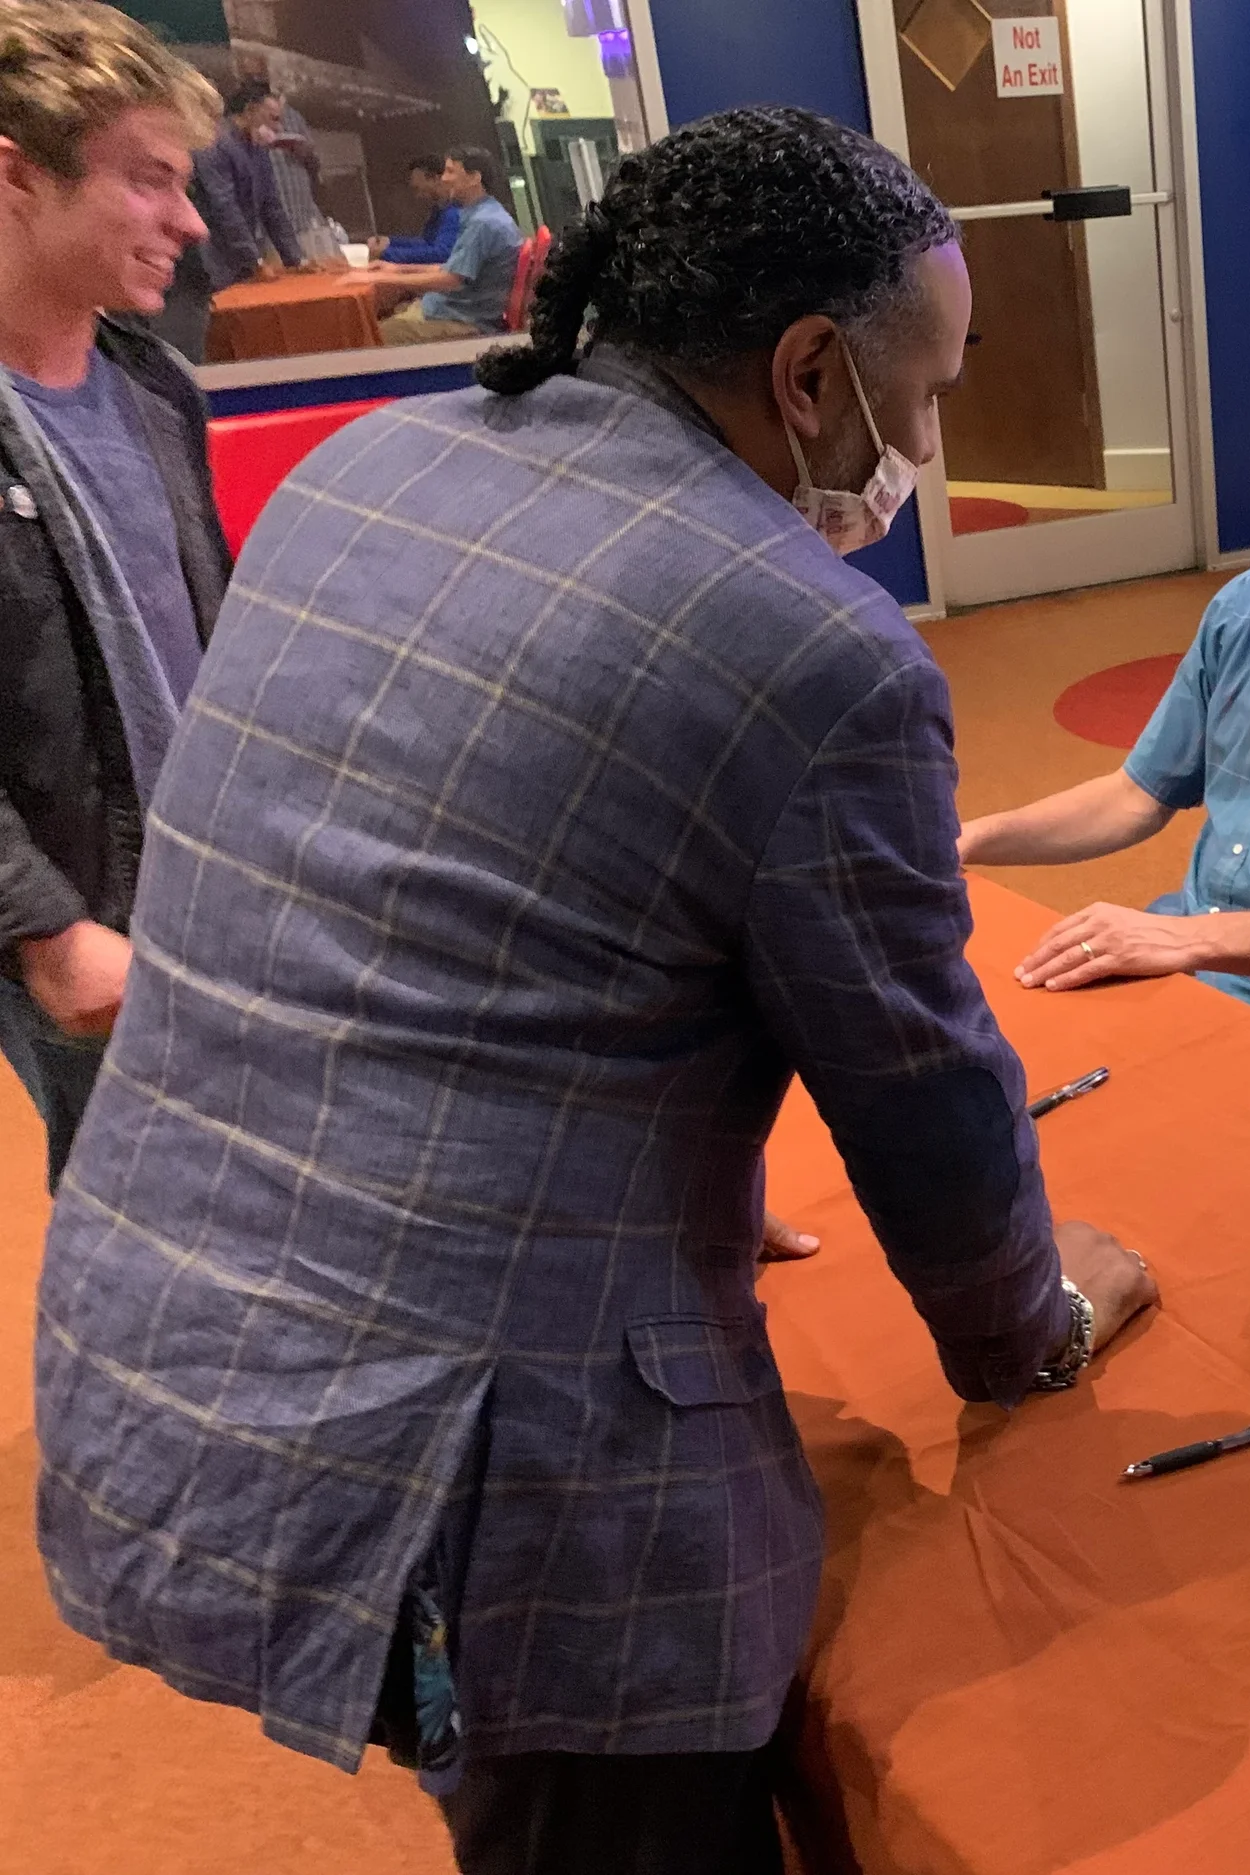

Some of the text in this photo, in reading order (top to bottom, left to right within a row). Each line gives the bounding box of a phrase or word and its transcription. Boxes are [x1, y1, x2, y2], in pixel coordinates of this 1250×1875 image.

[1012, 26, 1041, 49] Not
[1002, 62, 1058, 88] An Exit
